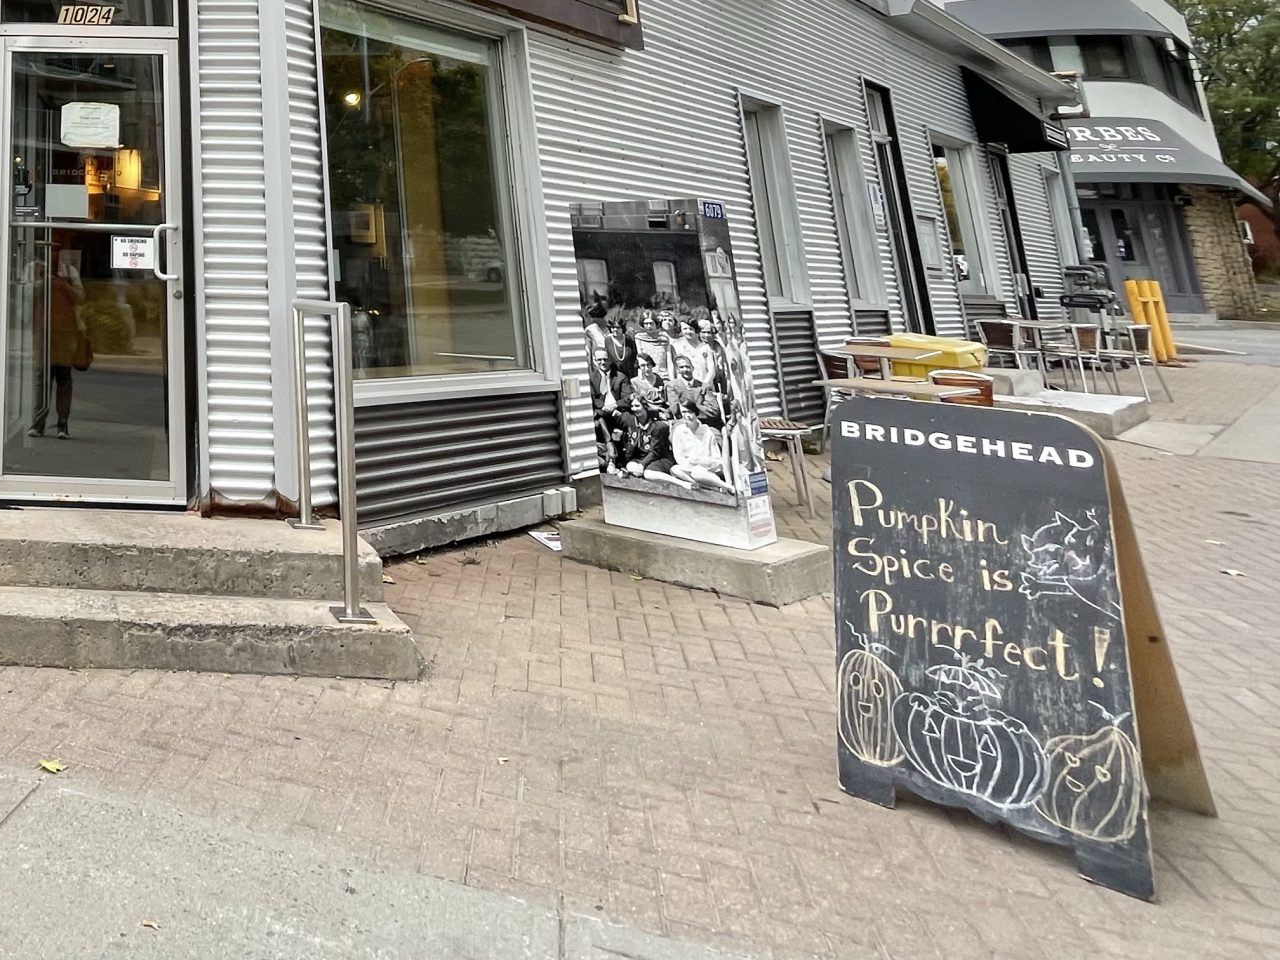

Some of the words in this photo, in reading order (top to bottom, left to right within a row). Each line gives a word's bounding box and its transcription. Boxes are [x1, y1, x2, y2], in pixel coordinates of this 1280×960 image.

[61, 6, 113, 24] 1024
[1067, 126, 1162, 142] RBES
[1070, 153, 1147, 163] EAUTY
[840, 420, 1094, 469] BRIDGEHEAD
[847, 479, 1009, 544] Pumpkin
[847, 537, 955, 586] Spice
[978, 558, 1013, 591] is
